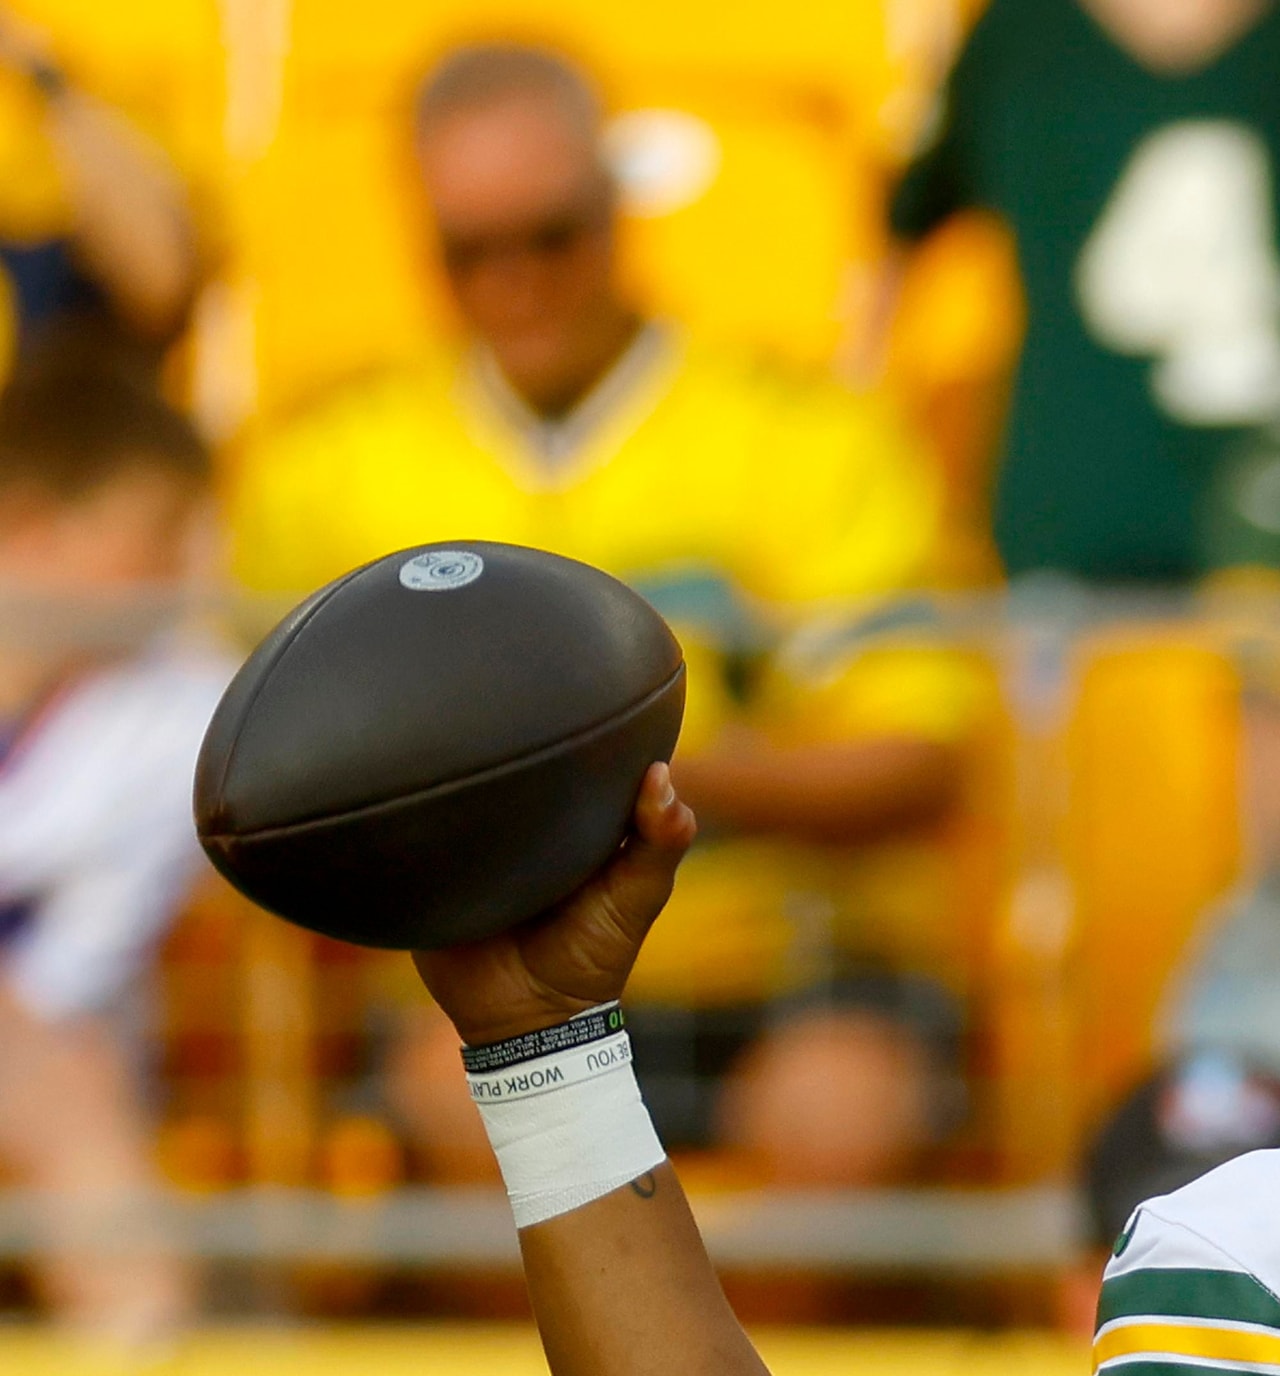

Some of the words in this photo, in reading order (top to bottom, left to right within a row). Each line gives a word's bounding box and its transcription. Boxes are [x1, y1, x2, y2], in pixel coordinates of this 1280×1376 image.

[586, 1047, 618, 1071] YOU
[472, 1080, 502, 1098] PLAY
[507, 1066, 565, 1094] WORK
